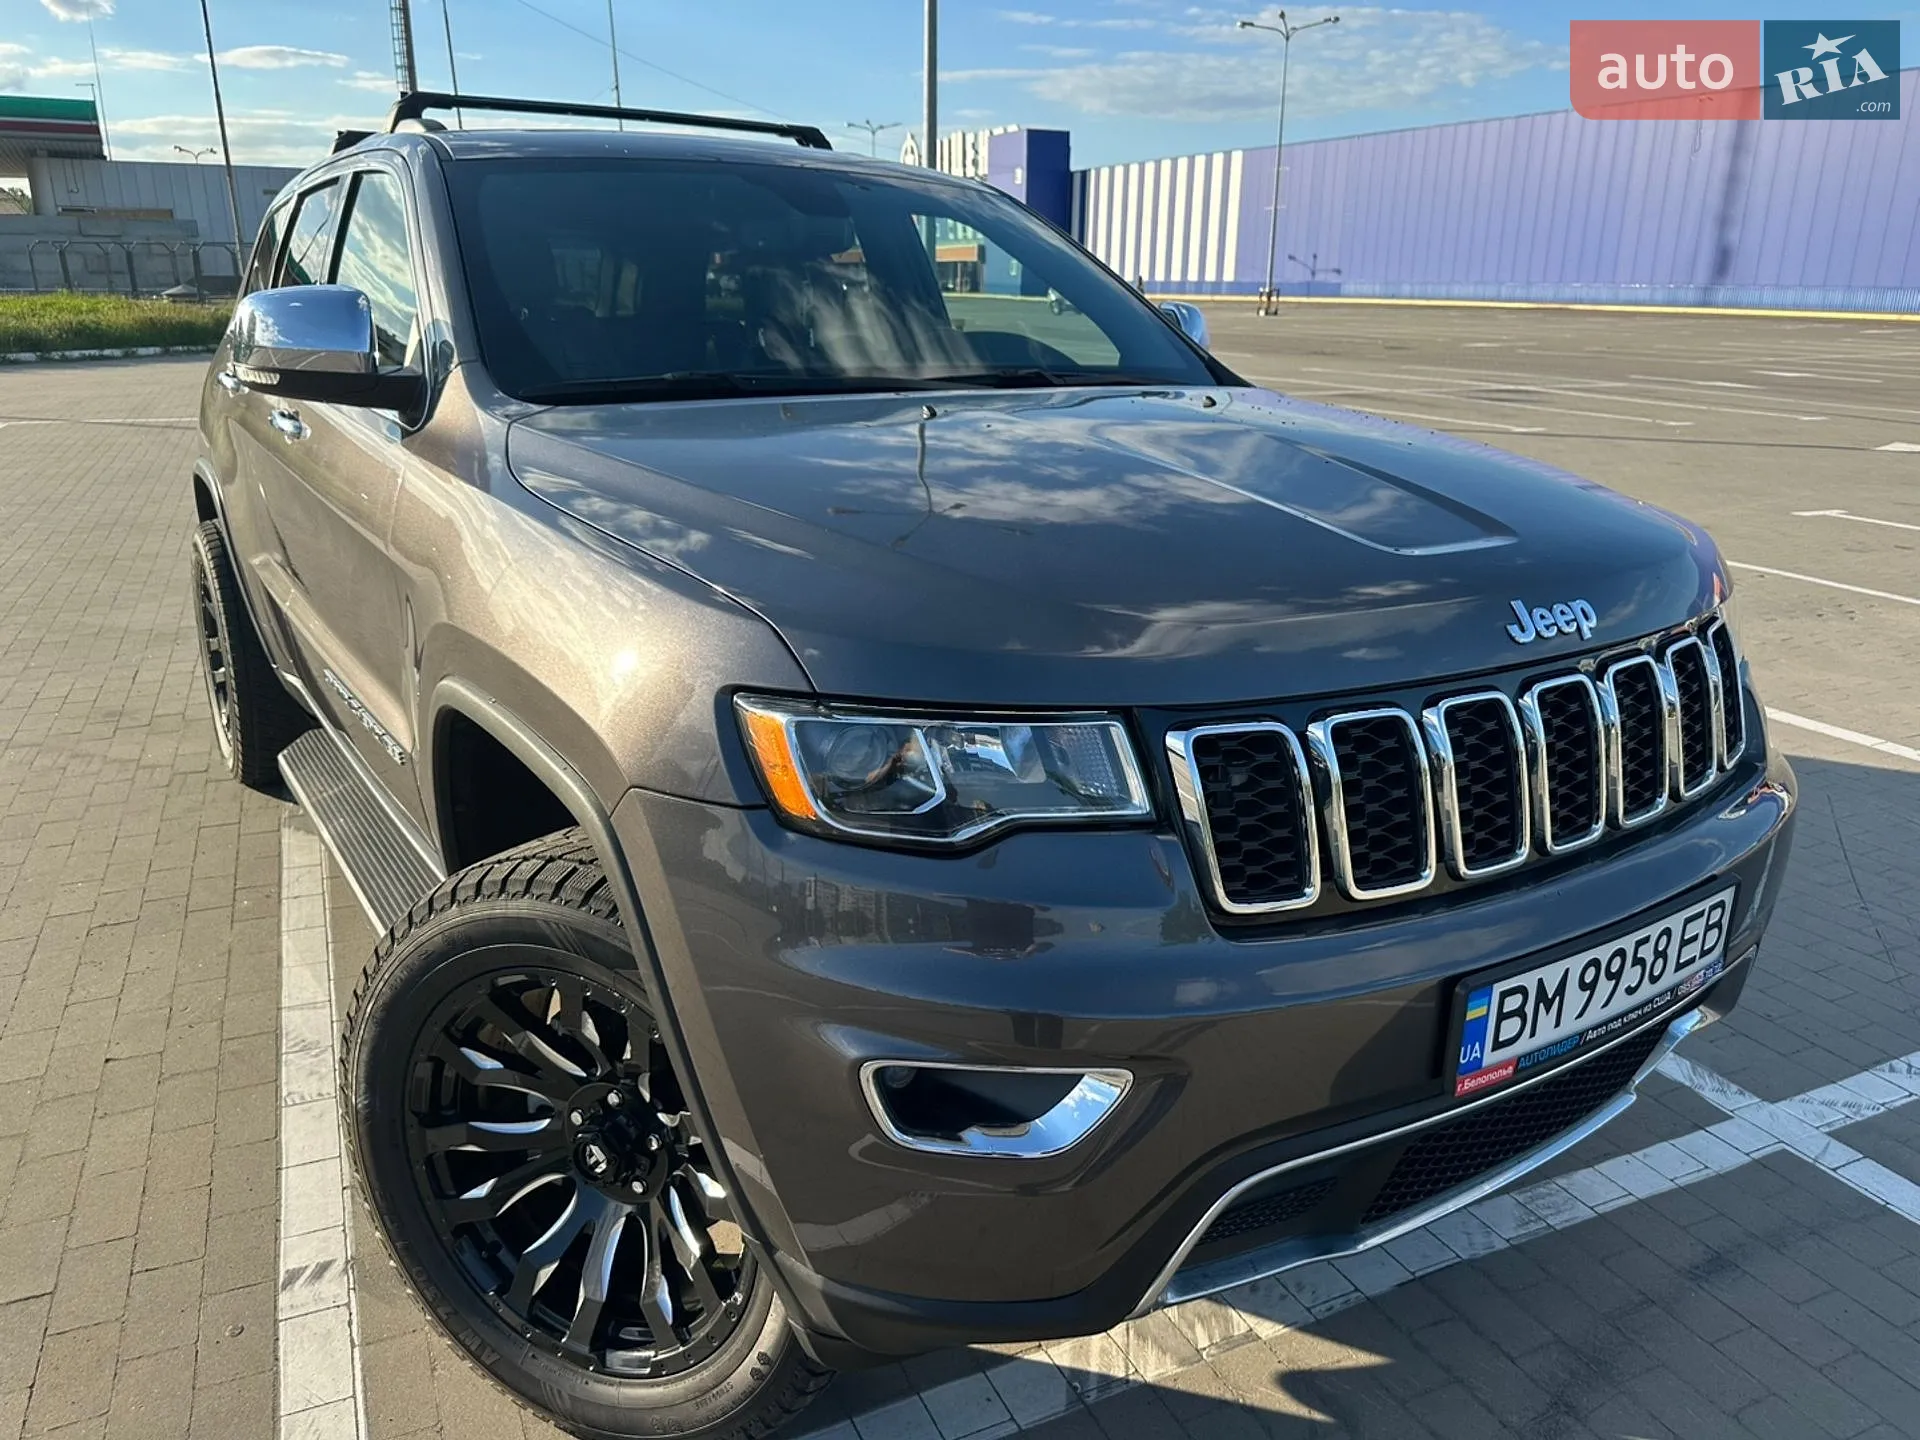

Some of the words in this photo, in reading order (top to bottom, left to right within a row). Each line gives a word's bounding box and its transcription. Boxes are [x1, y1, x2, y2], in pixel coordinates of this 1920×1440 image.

[1506, 598, 1598, 644] Jeep
[1491, 967, 1570, 1053] BM
[1574, 926, 1673, 1021] 9958
[1674, 899, 1727, 974] EB
[1459, 1041, 1481, 1064] UA
